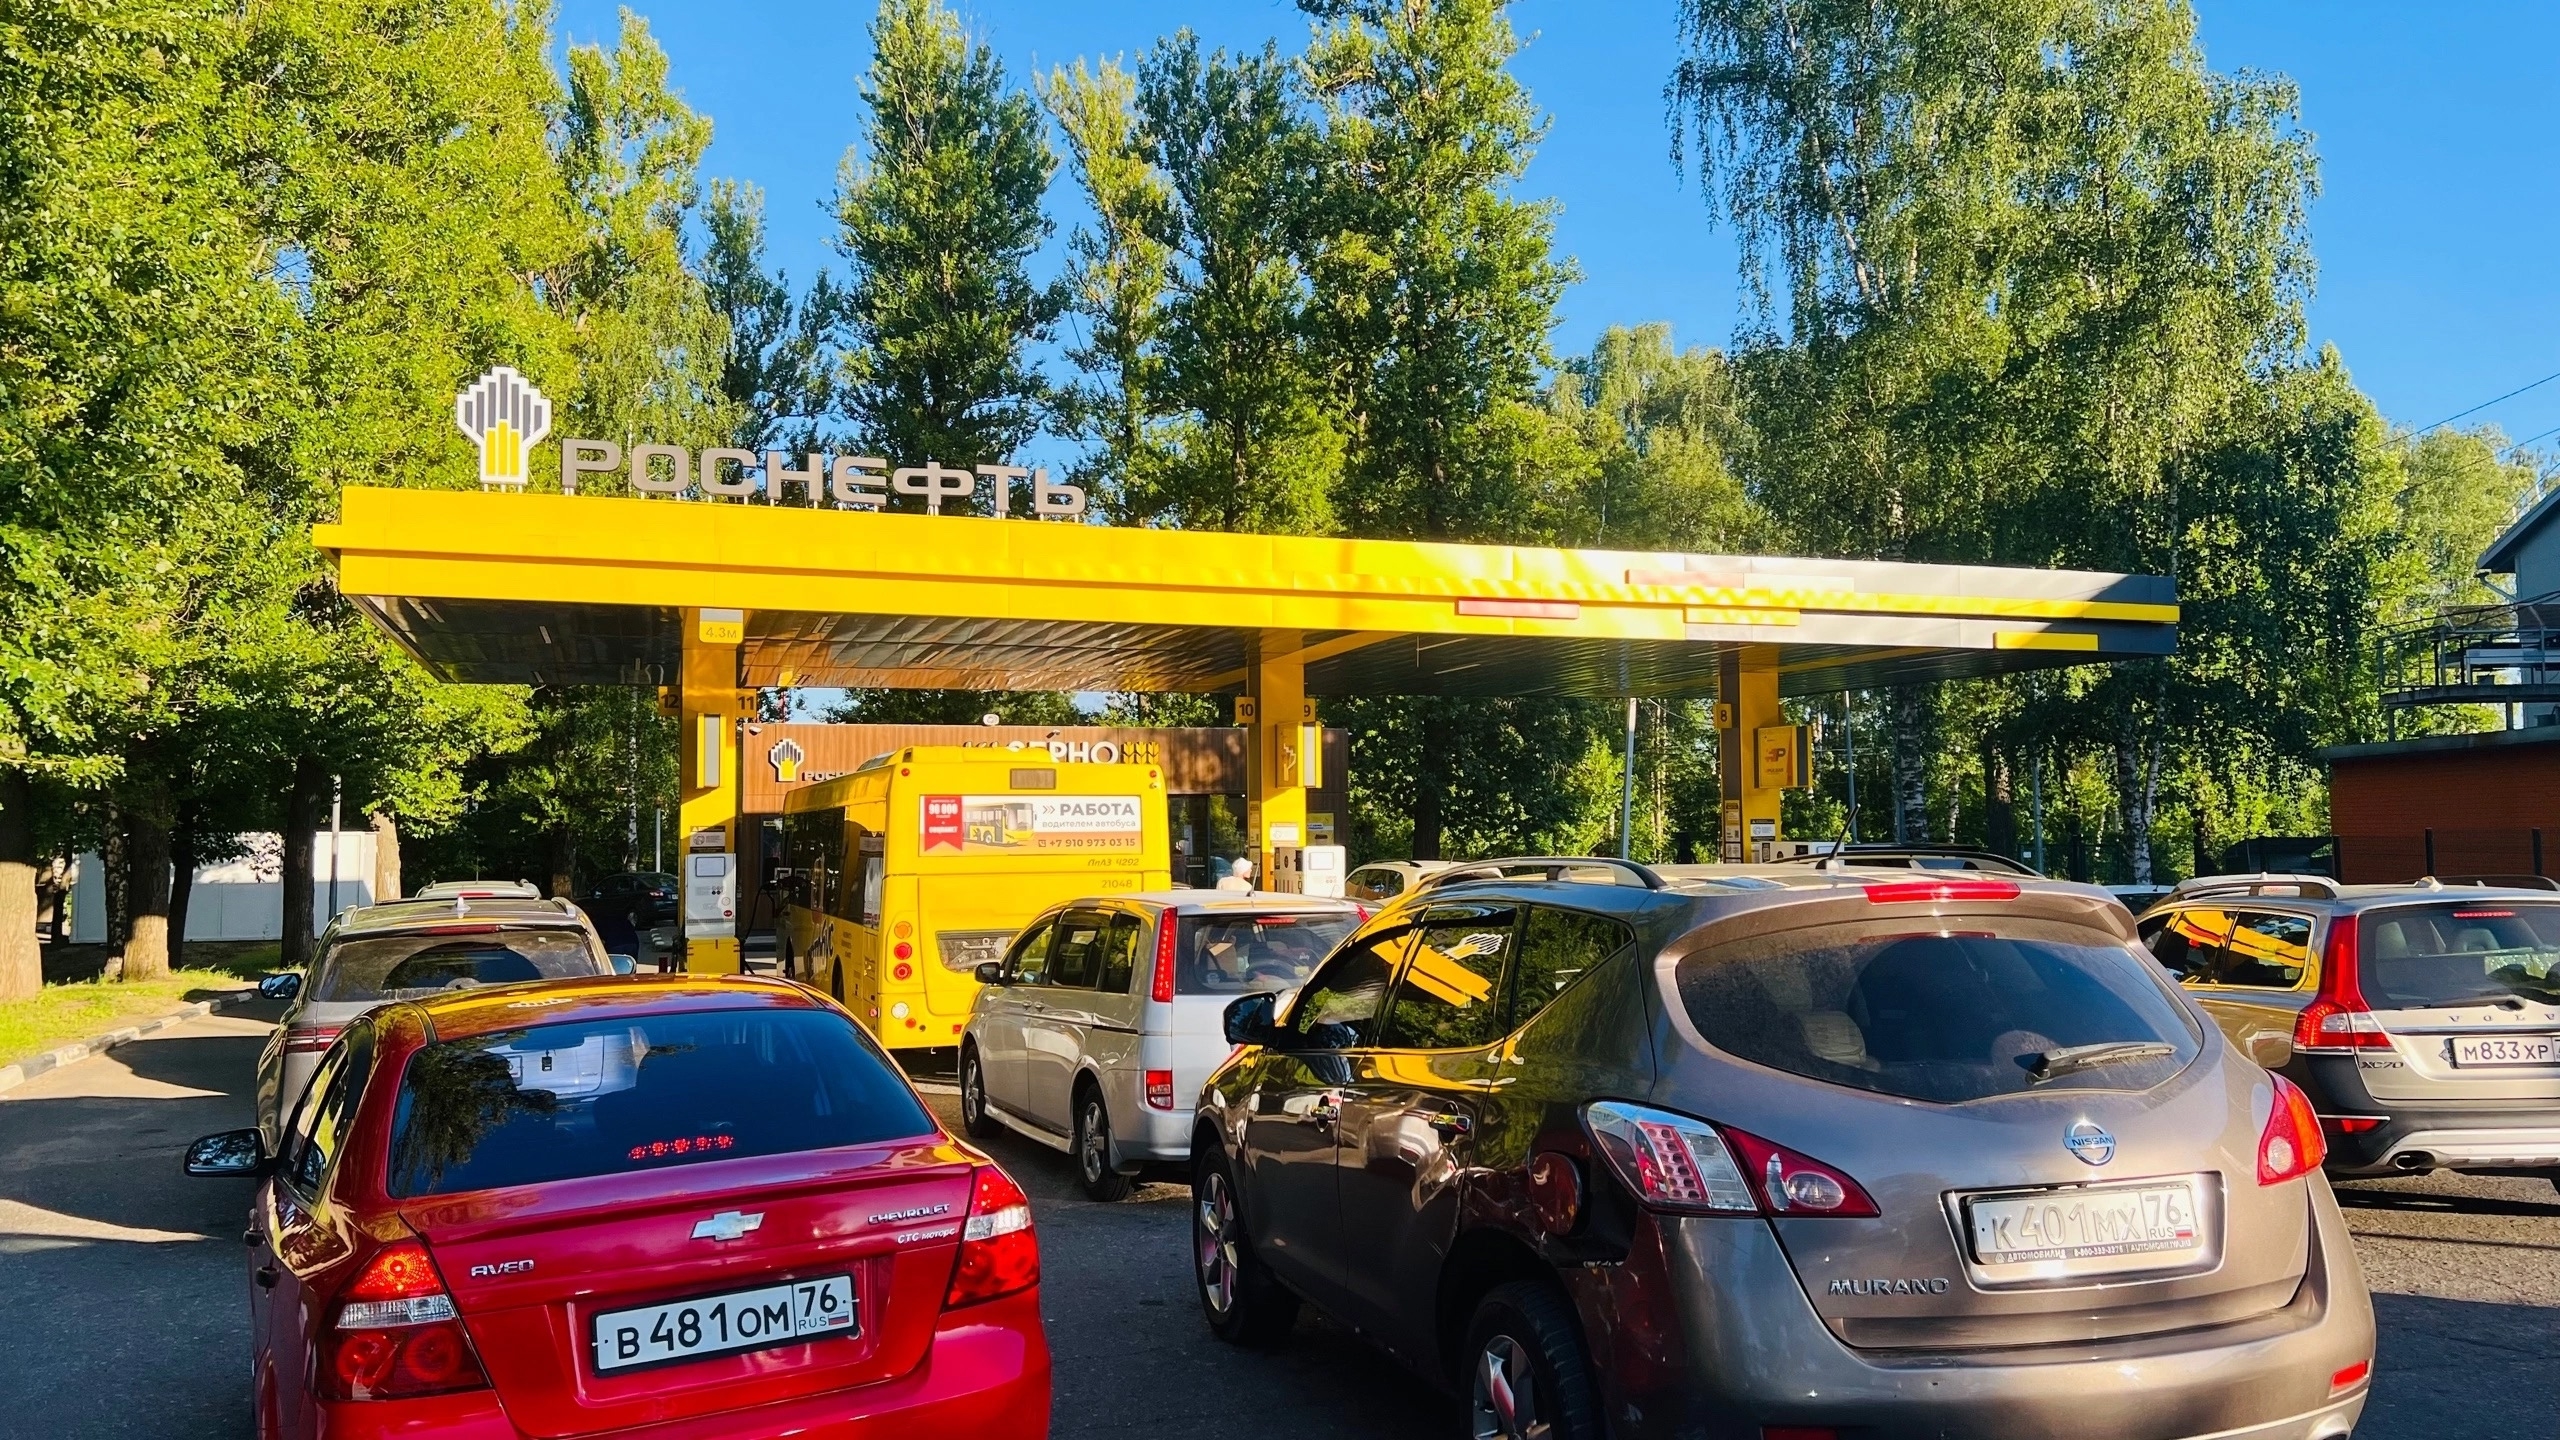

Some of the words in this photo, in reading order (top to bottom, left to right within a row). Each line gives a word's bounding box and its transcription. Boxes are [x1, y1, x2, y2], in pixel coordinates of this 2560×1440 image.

[561, 437, 1086, 515] РОСНЕФТЬ
[660, 694, 680, 709] 12
[737, 696, 755, 711] 11
[1238, 703, 1254, 717] 10
[1303, 704, 1311, 718] 9
[1720, 709, 1728, 722] 8
[1059, 803, 1135, 816] РАБОТА
[1042, 819, 1093, 828] водителем
[1095, 818, 1136, 828] автобуса
[1049, 839, 1062, 847] +7
[1065, 838, 1084, 847] 910
[1086, 838, 1106, 847] 973
[1109, 838, 1122, 846] 03
[1125, 838, 1136, 846] 15
[1116, 858, 1139, 867] 4292
[1101, 880, 1133, 888] 21048
[2359, 1060, 2405, 1069] XC70
[2072, 1135, 2113, 1147] NISSAN
[868, 1203, 950, 1225] CHEVROLET
[2145, 1194, 2182, 1227] 76
[2149, 1226, 2175, 1239] RUS
[471, 1259, 534, 1277] AVEO
[1827, 1277, 1950, 1296] MURANO
[797, 1283, 838, 1315] 76
[798, 1314, 828, 1331] RUS
